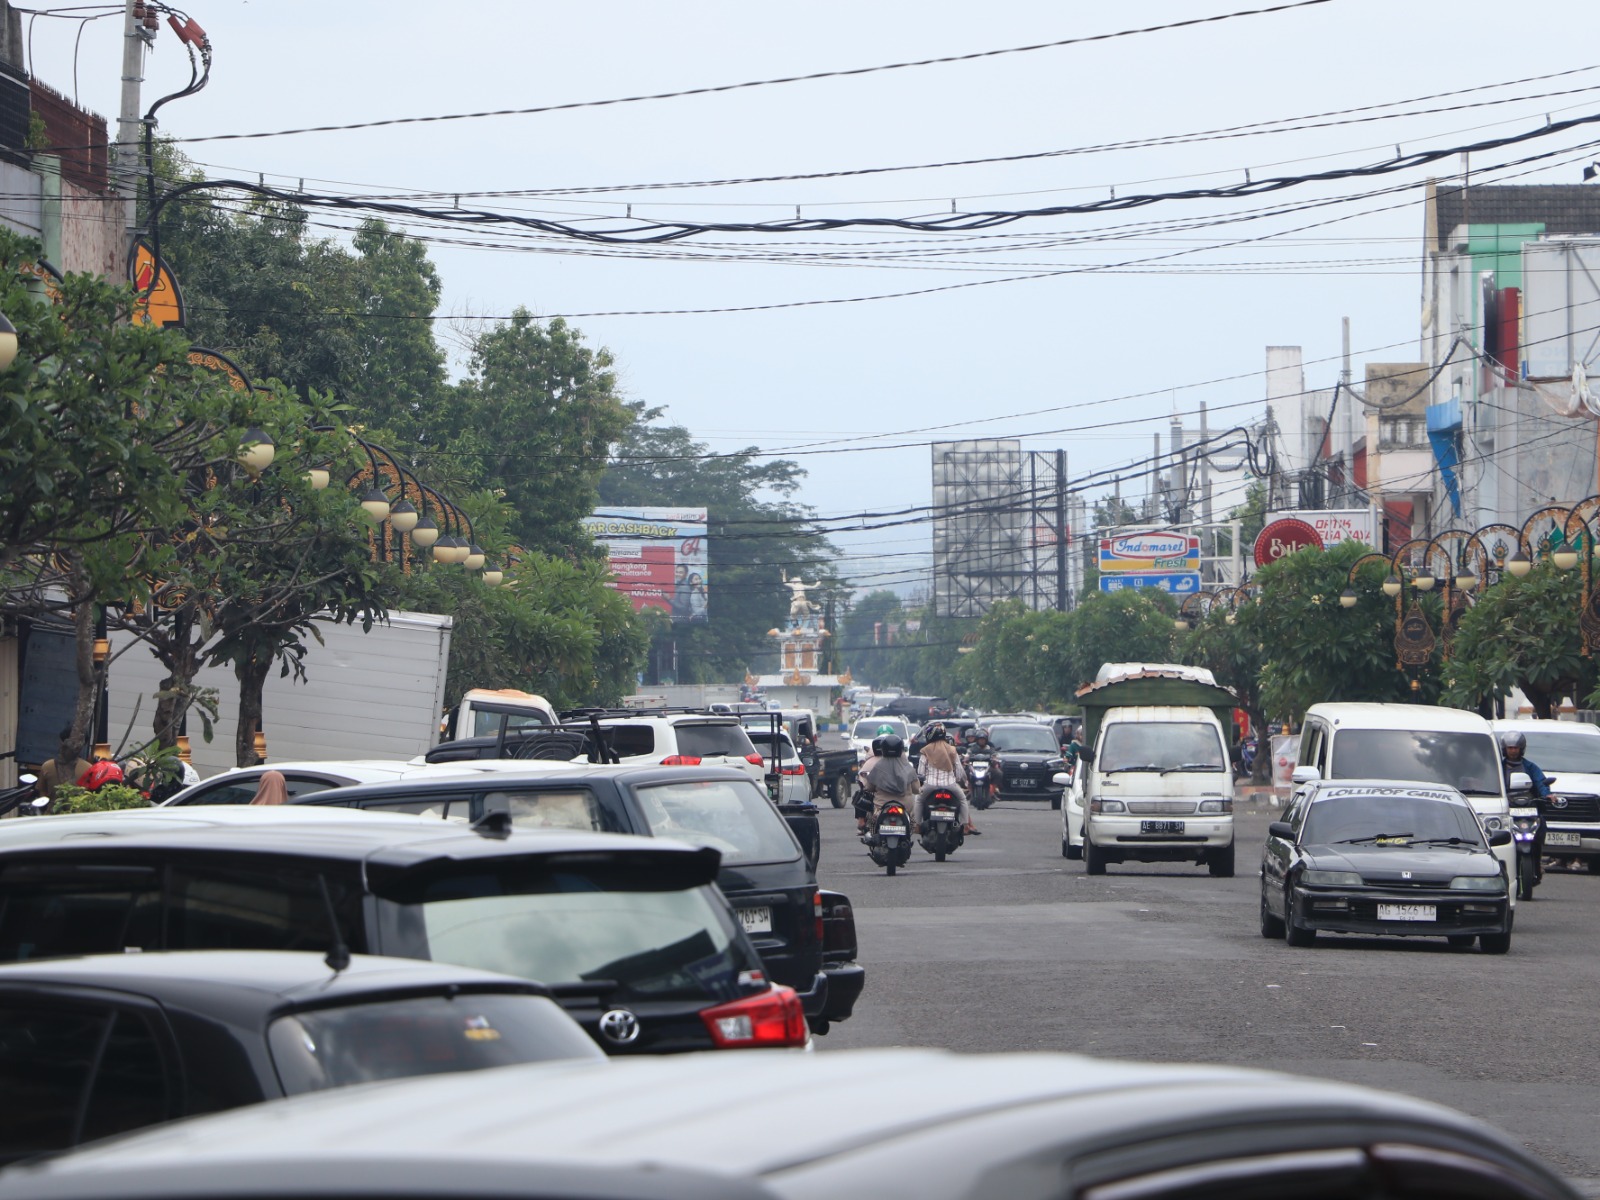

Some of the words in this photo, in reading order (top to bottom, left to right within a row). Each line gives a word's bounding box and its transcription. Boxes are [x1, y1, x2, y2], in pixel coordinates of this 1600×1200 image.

[608, 523, 677, 536] CASHBACK
[1116, 540, 1183, 552] Indomaret
[1153, 557, 1187, 569] Fresh
[1327, 788, 1404, 798] LOLLIPOP
